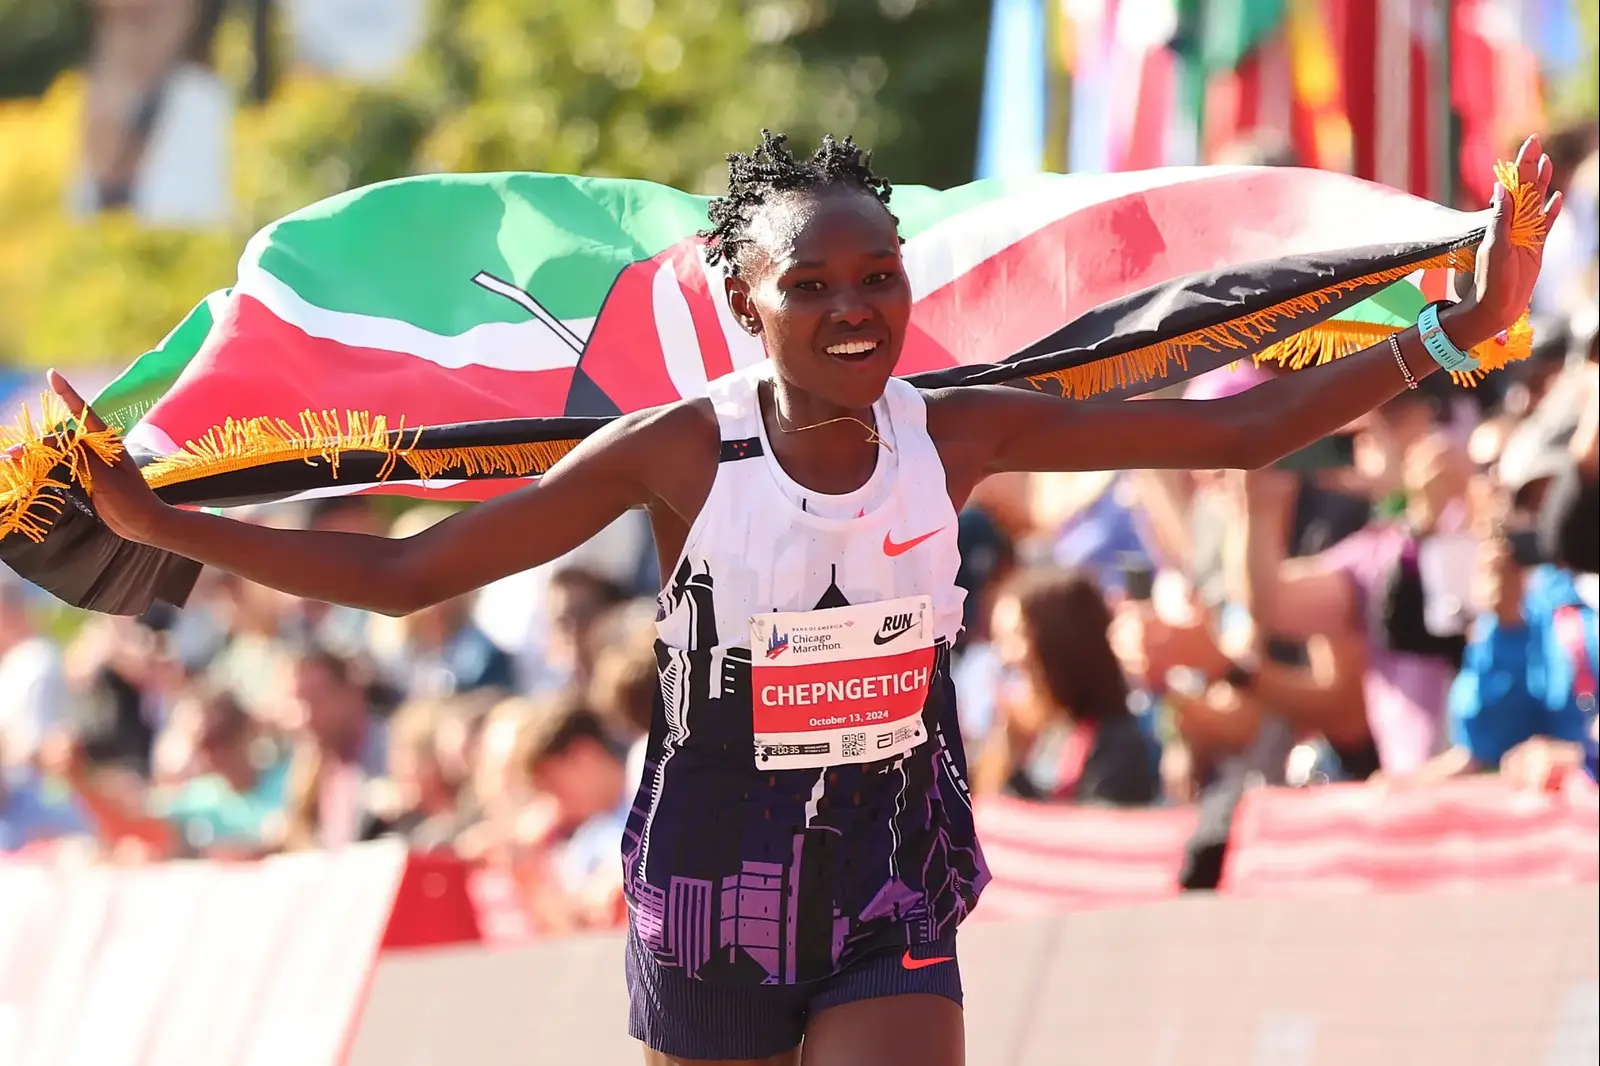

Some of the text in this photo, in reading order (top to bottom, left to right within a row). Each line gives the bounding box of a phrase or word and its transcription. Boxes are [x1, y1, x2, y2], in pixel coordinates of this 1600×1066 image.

[882, 612, 913, 633] RUN
[792, 633, 832, 644] Chicago
[761, 666, 928, 706] CHEPNGETICH
[809, 710, 889, 727] October 13, 2024
